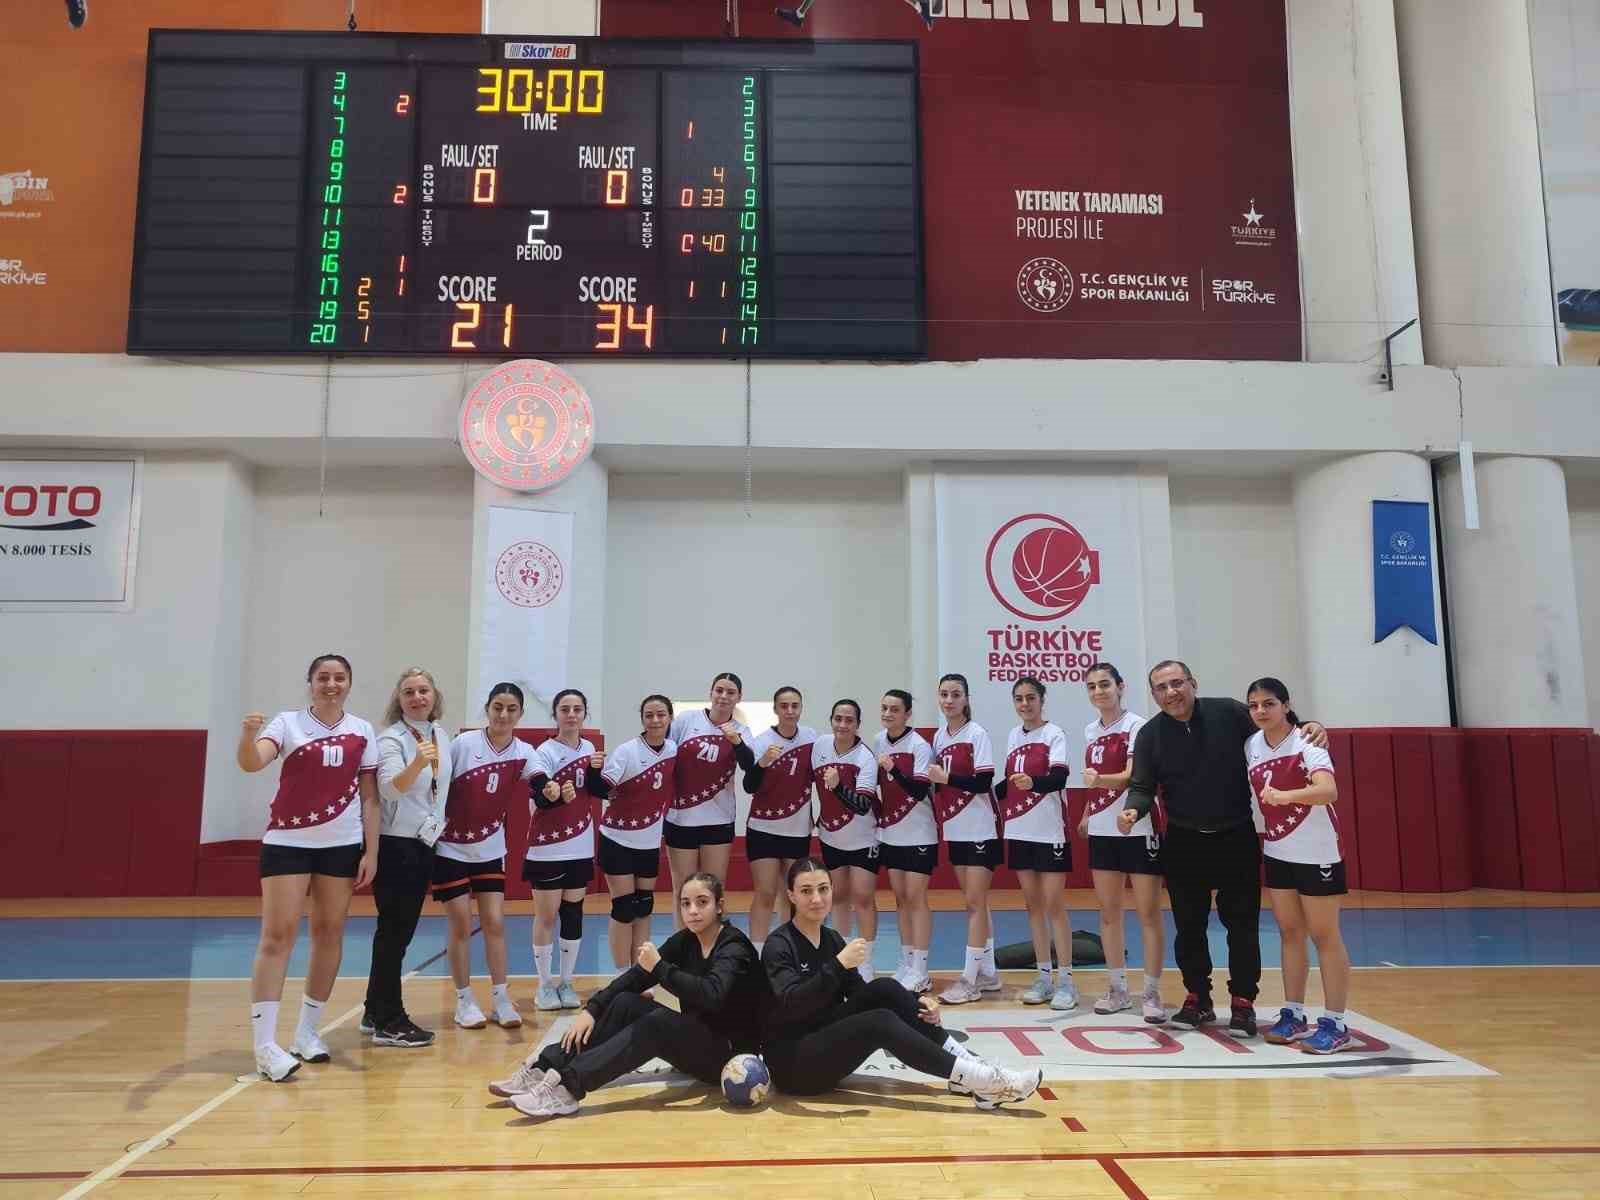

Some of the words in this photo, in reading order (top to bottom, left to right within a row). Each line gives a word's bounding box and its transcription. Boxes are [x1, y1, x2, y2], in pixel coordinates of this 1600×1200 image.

[522, 45, 570, 58] Skorled
[334, 72, 345, 89] 3
[743, 77, 754, 95] 2
[476, 68, 604, 113] 30:00
[334, 95, 345, 111] 4
[397, 95, 409, 113] 2
[743, 100, 754, 117] 3
[335, 117, 345, 134] 7
[521, 113, 558, 131] TIME
[744, 122, 754, 139] 5
[330, 140, 343, 158] 8
[441, 144, 498, 168] FAUL/SET
[579, 146, 635, 170] FAUL/SET
[744, 144, 754, 161] 6
[330, 162, 343, 180] 9
[713, 167, 724, 183] 4
[745, 166, 755, 183] 7
[423, 164, 434, 202] BONUS
[473, 168, 496, 203] 0
[605, 170, 628, 204] 0
[324, 185, 341, 203] 10
[394, 185, 406, 204] 2
[701, 189, 725, 207] 33
[745, 189, 755, 207] 9
[1015, 190, 1080, 212] YETENEK
[1083, 192, 1163, 215] TARAMASI
[323, 209, 341, 225] 11
[741, 212, 755, 230] 10
[526, 209, 549, 245] 2
[1016, 216, 1077, 239] PROJESİ
[1084, 216, 1104, 240] İLE
[322, 231, 340, 249] 13
[702, 234, 725, 252] 40
[741, 235, 756, 252] 11
[516, 244, 562, 261] PERIOD
[321, 254, 338, 272] 16
[741, 257, 757, 275] 12
[320, 277, 338, 295] 17
[358, 278, 371, 296] 2
[438, 276, 497, 302] SCORE
[578, 276, 637, 303] SCORE
[741, 281, 757, 298] 13
[1080, 273, 1104, 284] T.C.
[1108, 273, 1167, 288] GENÇLİK
[1171, 276, 1188, 287] VE
[1081, 288, 1115, 299] SPOR
[1119, 288, 1189, 302] BAKANLIĞI
[320, 301, 337, 319] 19
[358, 301, 369, 320] 5
[741, 304, 757, 321] 14
[310, 324, 337, 343] 20
[451, 302, 513, 348] 21
[595, 303, 653, 348] 34
[741, 327, 758, 344] 17
[0, 486, 101, 516] OTO
[12, 544, 46, 556] 8.000
[49, 542, 93, 556] TESİS
[987, 625, 1102, 651] TÜRKİYE
[322, 745, 344, 767] 10
[696, 741, 720, 763] 20
[788, 757, 799, 776] 7
[485, 772, 500, 793] 9
[575, 768, 585, 788] 6
[652, 771, 663, 789] 3
